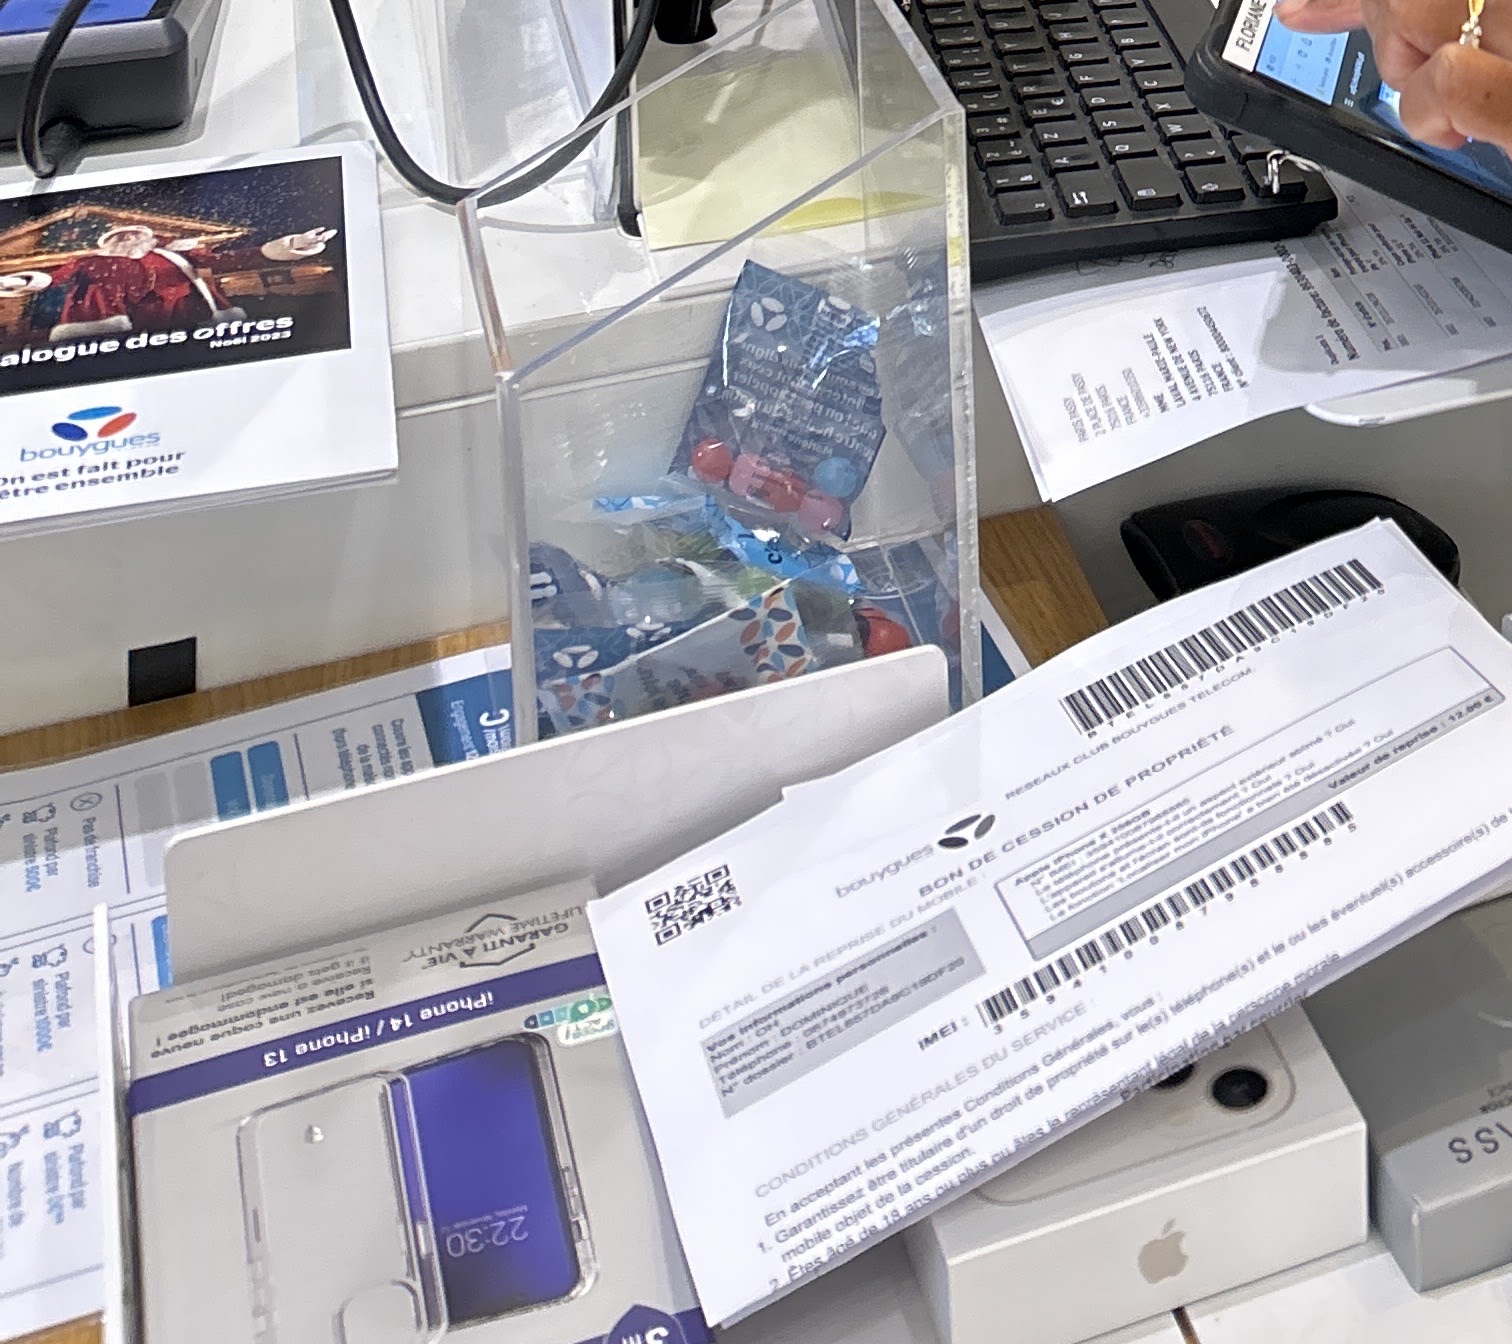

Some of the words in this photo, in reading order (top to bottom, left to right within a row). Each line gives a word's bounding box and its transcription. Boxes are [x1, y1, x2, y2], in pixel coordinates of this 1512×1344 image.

[0, 340, 119, 369] alogue
[125, 329, 188, 352] des
[193, 315, 295, 342] offres
[209, 335, 248, 350] Noël
[250, 330, 292, 345] 2023
[19, 430, 162, 465] bouygues
[32, 467, 72, 484] est
[77, 460, 120, 479] fait
[124, 451, 186, 471] pour
[54, 463, 181, 494] ensemble
[1072, 740, 1110, 766] CLUB
[1110, 699, 1187, 746] BOUYGUES
[1327, 762, 1371, 791] Valeur
[1372, 750, 1391, 766] de
[1391, 724, 1439, 756] reprise
[917, 867, 961, 899] BON
[967, 848, 997, 872] DE
[999, 799, 1090, 855] CESSION
[1092, 782, 1120, 806] DE
[1123, 721, 1235, 789] PROPRIÉTÉ
[835, 838, 933, 901] bouygues
[510, 904, 583, 933] LIFETIME
[404, 924, 506, 961] WARRANTY
[461, 944, 475, 962] À
[481, 921, 569, 956] GARANTI
[426, 949, 457, 968] VIE
[53, 970, 73, 1011] Plafond
[323, 982, 355, 1000] elle
[737, 980, 832, 1035] informations
[835, 929, 928, 985] personnelles
[267, 1008, 300, 1025] une
[293, 992, 319, 1008] est
[303, 988, 375, 1015] Recevez
[418, 989, 494, 1022] iPhone
[55, 1011, 71, 1030] par
[165, 1000, 290, 1042] endommagée
[209, 1018, 263, 1042] coque
[388, 1011, 413, 1032] 14
[757, 1237, 773, 1255] 1.
[772, 1185, 867, 1247] Garantissez
[865, 1165, 898, 1193] être
[897, 1133, 955, 1175] titulaire
[954, 1112, 989, 1142] d'un
[988, 1092, 1023, 1121] droit
[1022, 1080, 1045, 1102] de
[1043, 1042, 1111, 1091] propriété
[1110, 1028, 1136, 1051] sur
[1134, 1006, 1170, 1038] le(s)
[1167, 957, 1256, 1018] téléphone(s)
[1255, 947, 1272, 965] et
[1271, 938, 1286, 956] le
[1286, 928, 1306, 948] ou
[1307, 913, 1329, 935] les
[1403, 819, 1491, 881] accessoire(s)
[1490, 809, 1509, 829] de
[917, 1020, 958, 1051] IMEI
[148, 1036, 205, 1060] neuve
[261, 1046, 288, 1067] 13
[293, 1023, 371, 1058] iPhone
[752, 1126, 870, 1200] CONDITIONS
[868, 1061, 980, 1133] GÉNÉRALES
[980, 1045, 1009, 1071] DU
[1009, 1000, 1088, 1053] SERVICE
[763, 1205, 787, 1228] En
[787, 1162, 864, 1215] acceptant
[863, 1148, 888, 1171] les
[888, 1107, 963, 1158] présentes
[961, 1060, 1041, 1114] Conditions
[1119, 995, 1155, 1022] vous
[779, 1225, 832, 1264] mobile
[832, 1201, 874, 1236] objet
[873, 1188, 896, 1210] de
[896, 1178, 913, 1197] la
[912, 1143, 977, 1188] cession.
[445, 1217, 528, 1255] 22:30
